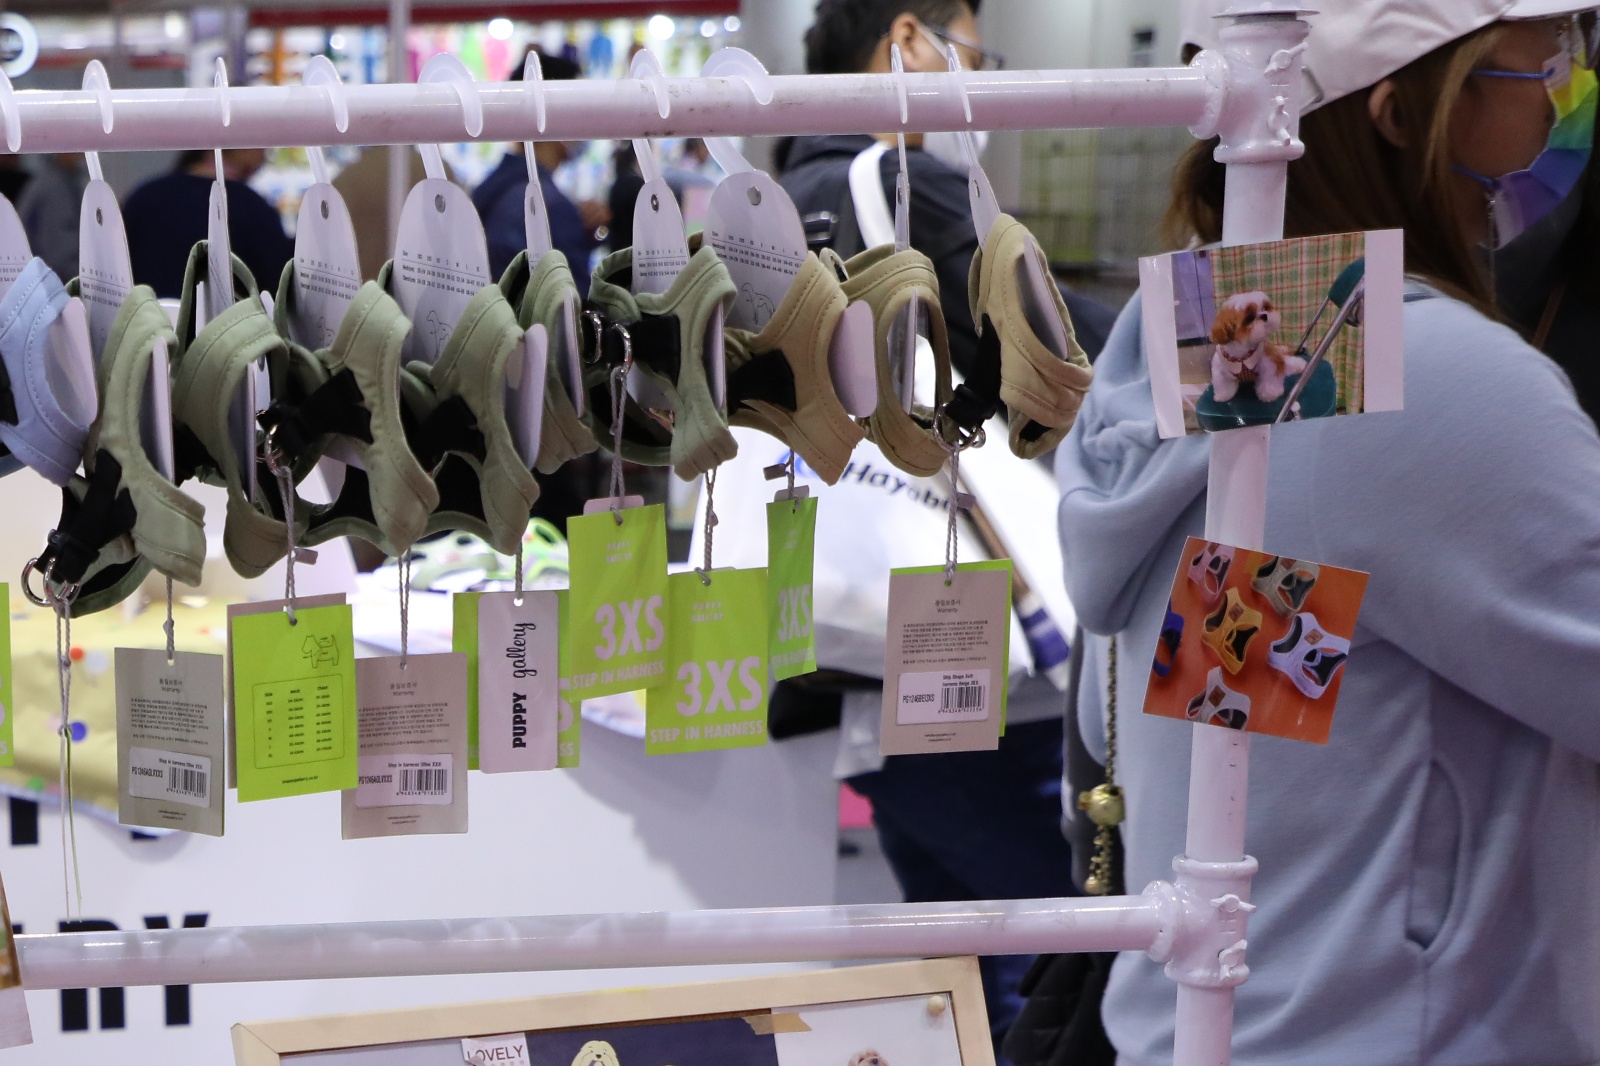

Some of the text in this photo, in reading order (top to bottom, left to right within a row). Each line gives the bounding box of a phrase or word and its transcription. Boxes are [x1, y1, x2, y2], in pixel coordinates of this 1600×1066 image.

[594, 594, 665, 662] 3XS
[777, 583, 811, 644] 3XS
[506, 622, 538, 749] PUPPY gallery
[572, 660, 664, 691] STEP IN HARNESS
[675, 656, 763, 717] 3XS
[650, 720, 764, 745] STEP IN HARNESS
